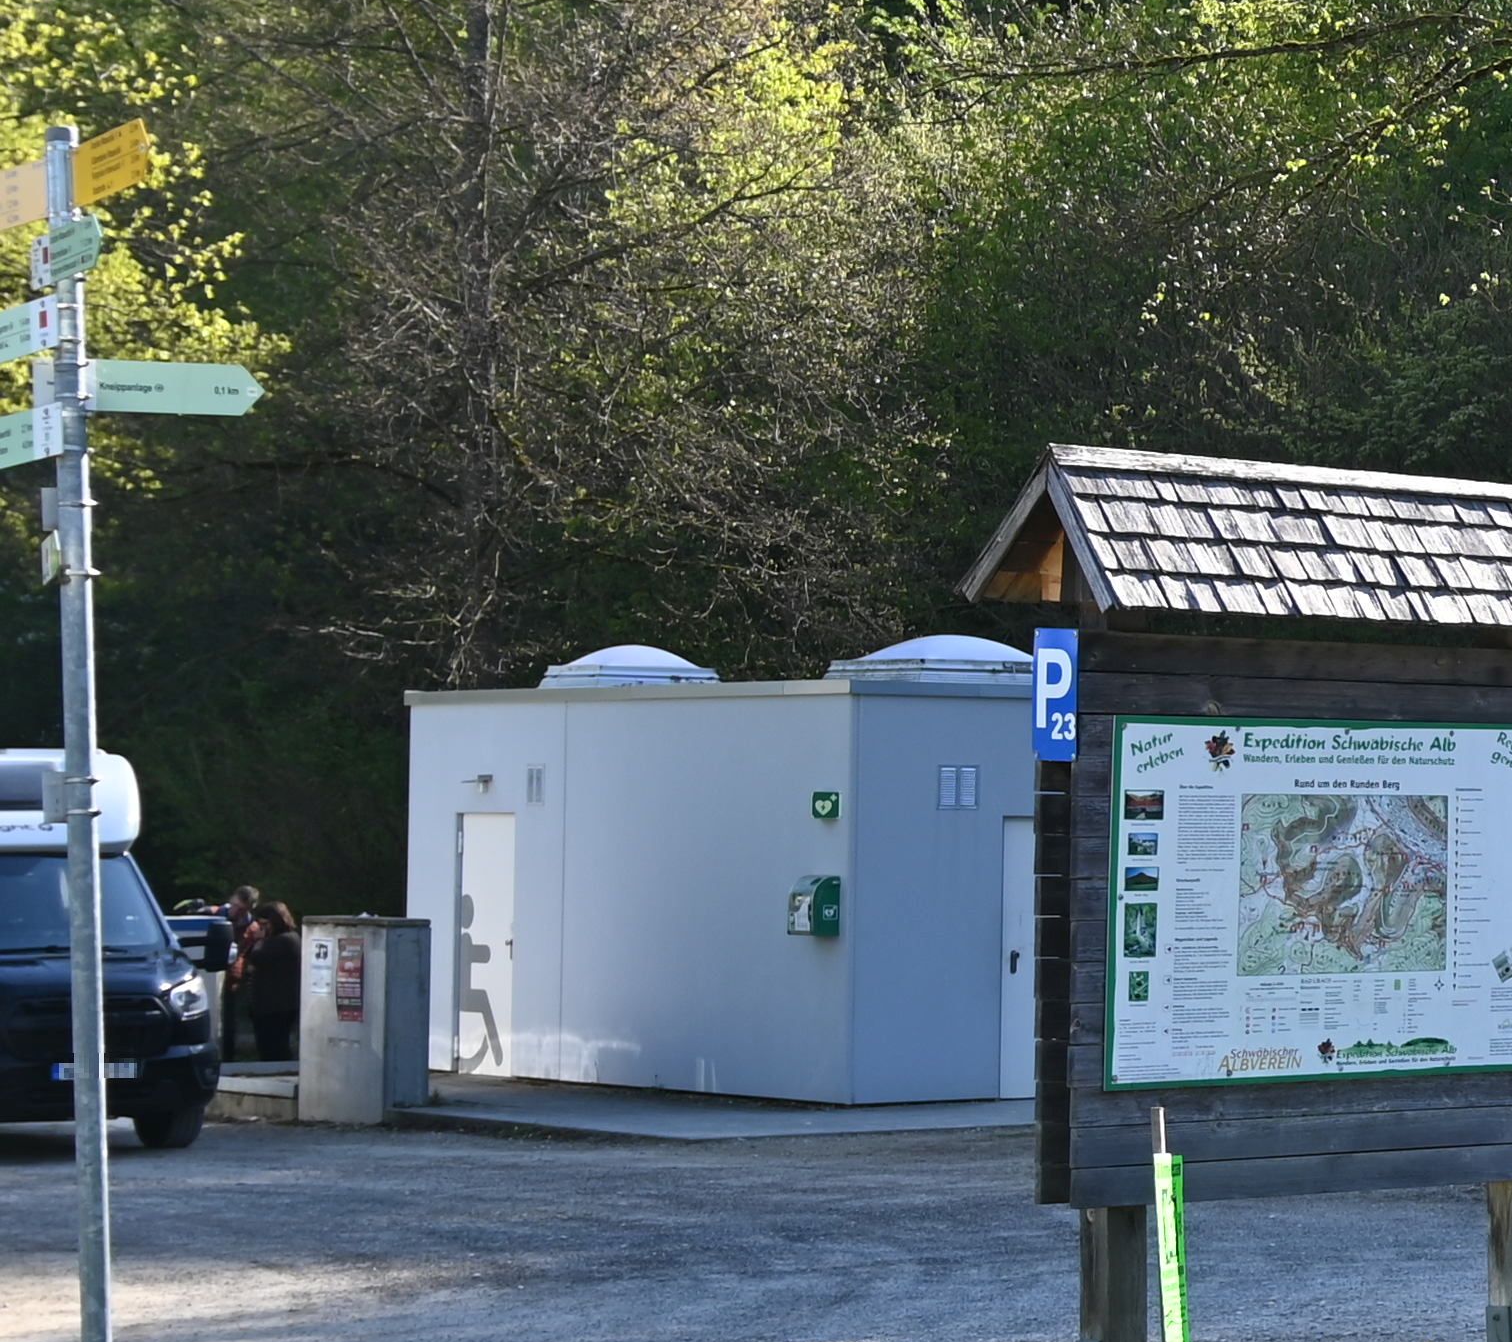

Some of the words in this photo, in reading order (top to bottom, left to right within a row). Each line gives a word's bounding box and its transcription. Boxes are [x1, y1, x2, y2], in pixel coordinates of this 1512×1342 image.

[100, 382, 153, 395] Kneippanlage
[214, 387, 226, 396] 0,1
[228, 387, 239, 396] km
[1036, 648, 1072, 728] P
[1051, 712, 1076, 740] 23
[1130, 732, 1173, 756] Natur
[1243, 732, 1326, 752] Expedition
[1332, 734, 1423, 752] Schwäbische
[1430, 736, 1456, 752] Alb
[1136, 746, 1185, 774] erleben
[1243, 754, 1282, 765] Wandern,
[1285, 754, 1316, 763] Erleben
[1319, 755, 1334, 763] und
[1336, 754, 1374, 764] Genießen
[1377, 755, 1389, 764] für
[1392, 755, 1406, 764] den
[1409, 755, 1455, 765] Naturschutz
[1294, 779, 1315, 788] Rund
[1333, 779, 1347, 788] den
[1350, 780, 1380, 789] Runden
[1382, 780, 1401, 791] Berg
[1230, 1047, 1299, 1059] Schwäbischer
[1218, 1055, 1303, 1072] ALBVEREIN
